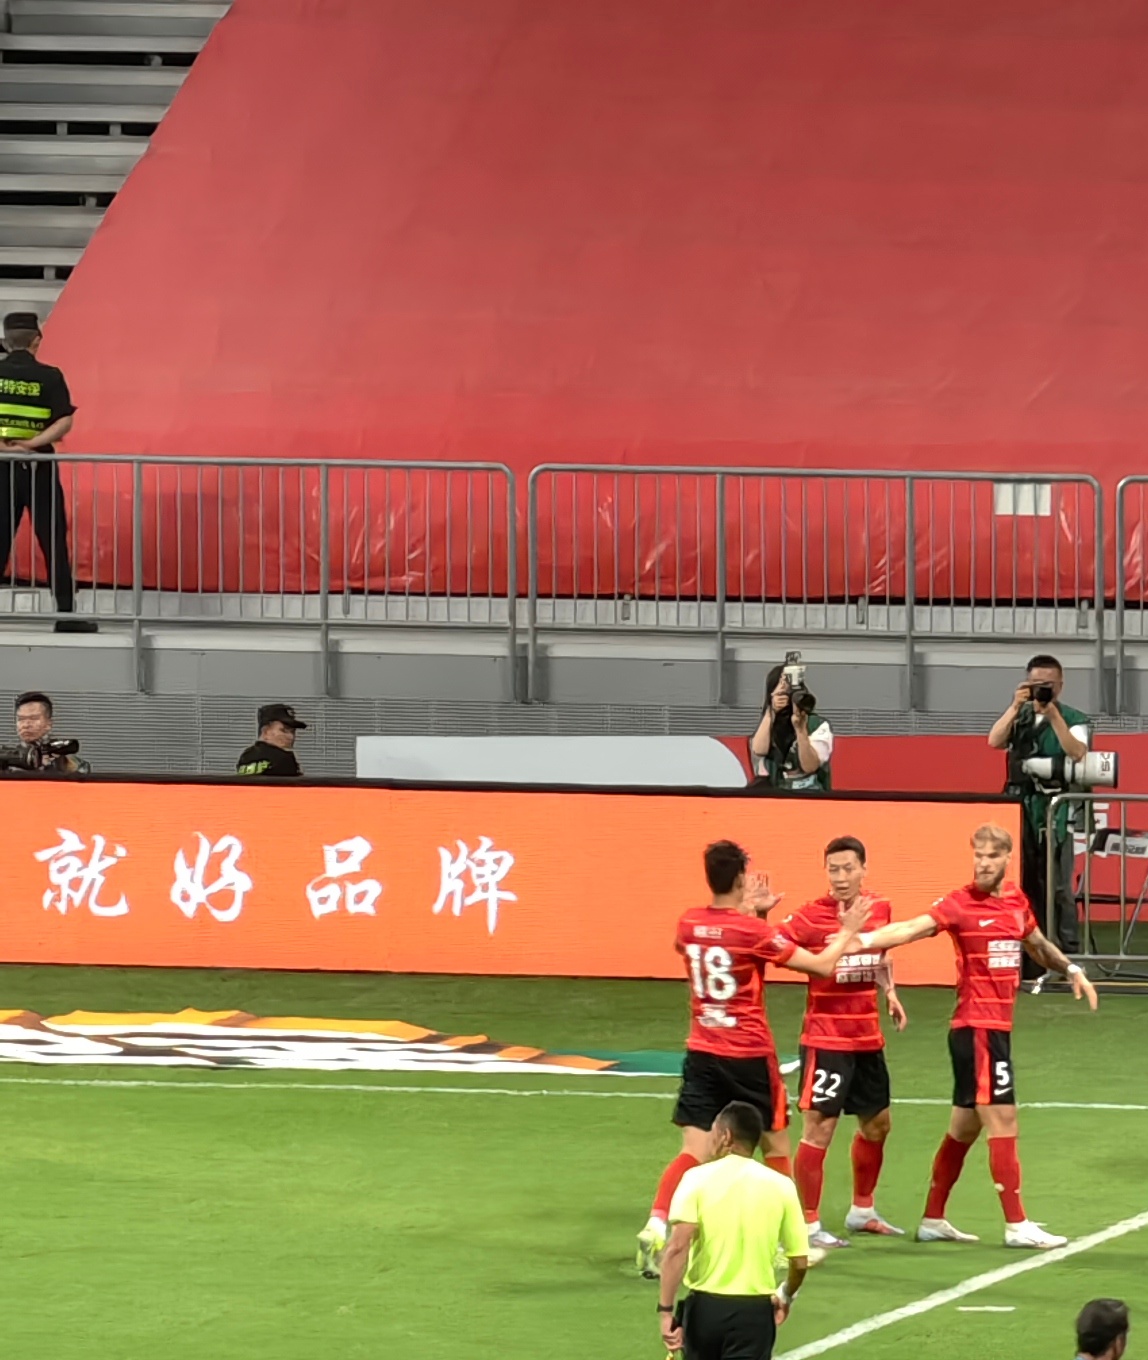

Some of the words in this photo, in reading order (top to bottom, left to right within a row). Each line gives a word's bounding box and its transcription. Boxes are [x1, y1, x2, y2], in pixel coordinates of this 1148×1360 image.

[34, 827, 519, 937] 就好品牌
[685, 943, 738, 1001] 18
[812, 1069, 842, 1098] 22
[995, 1061, 1010, 1086] 5
